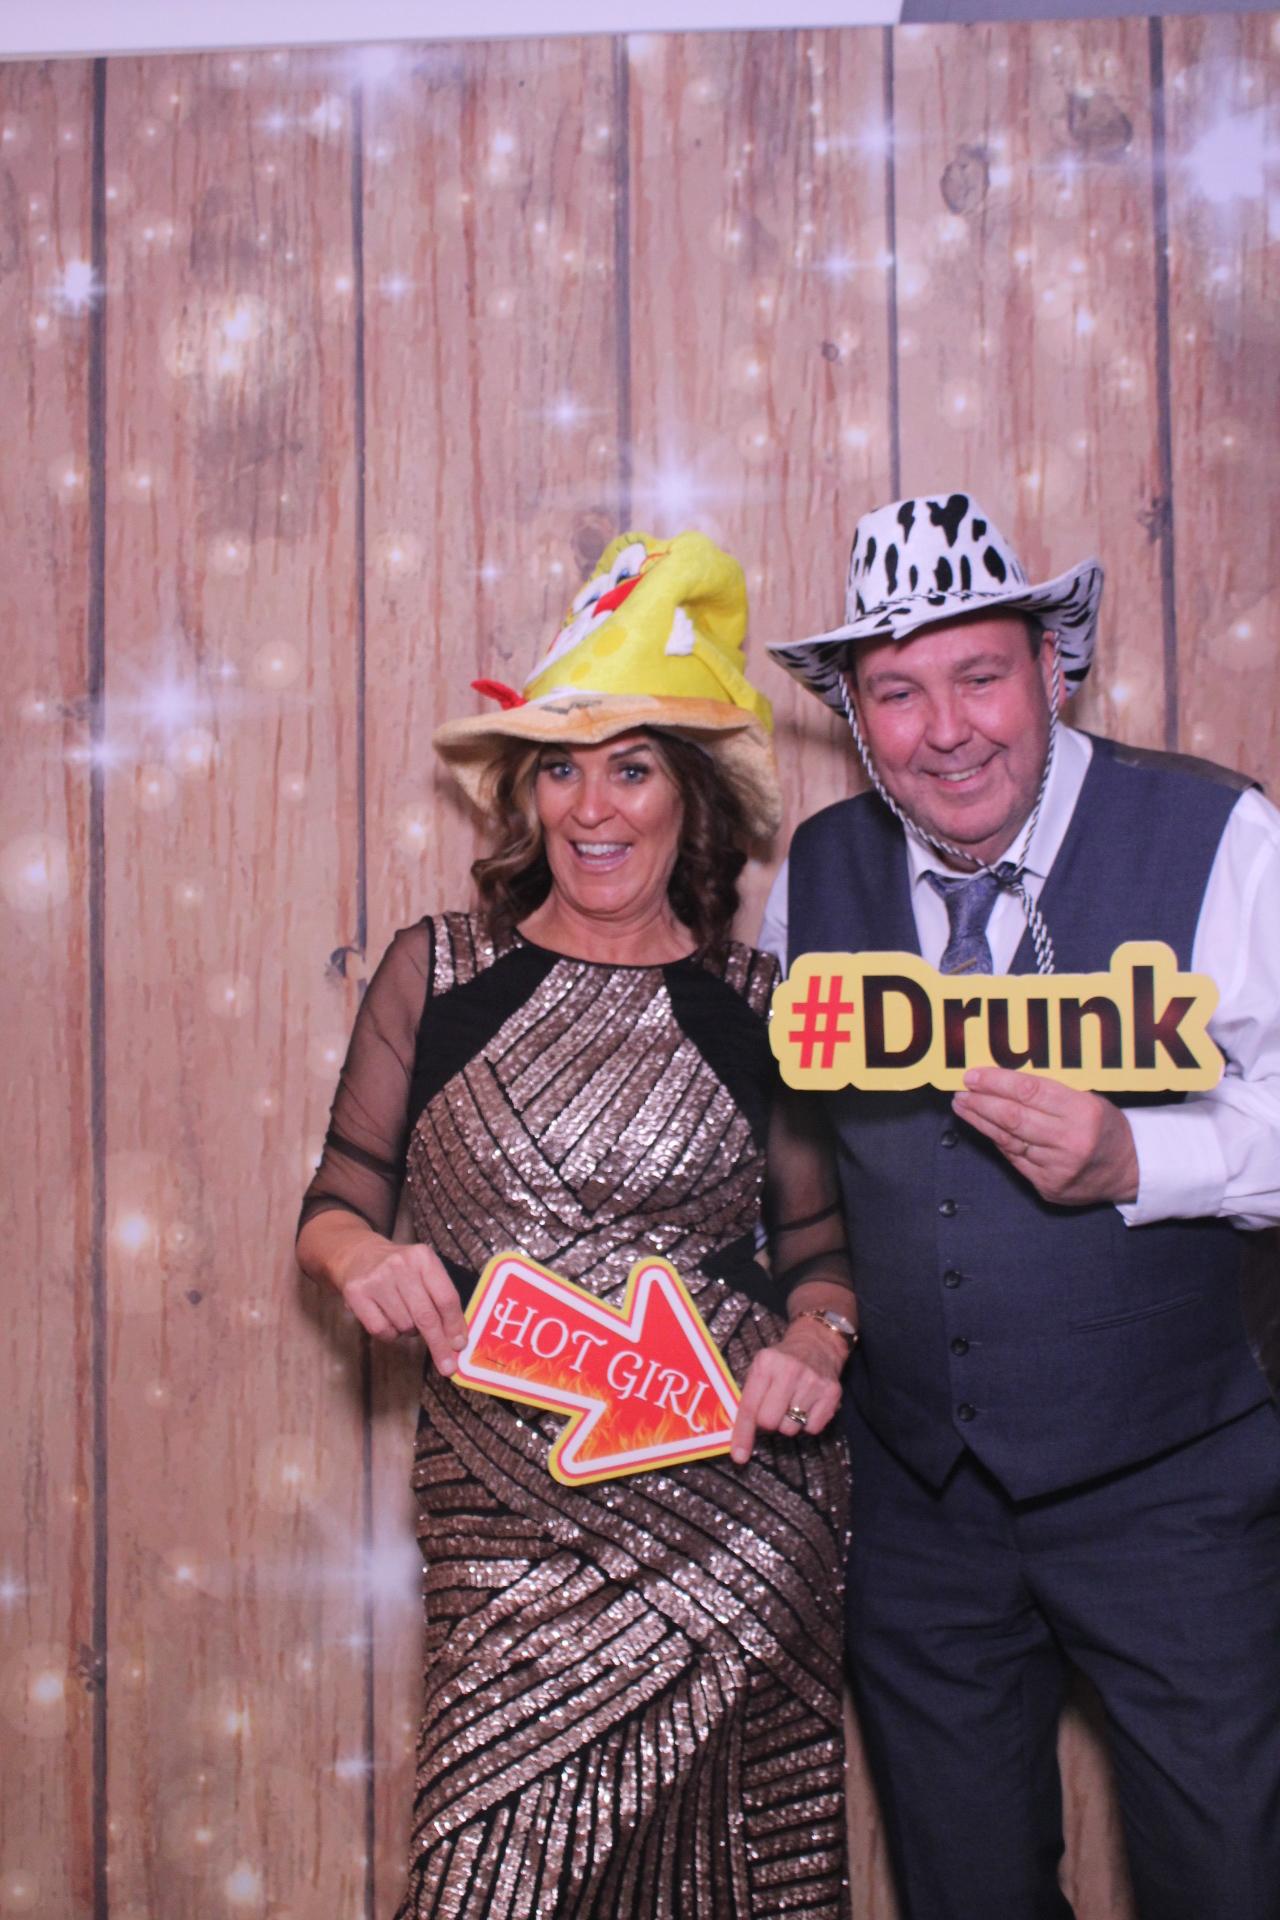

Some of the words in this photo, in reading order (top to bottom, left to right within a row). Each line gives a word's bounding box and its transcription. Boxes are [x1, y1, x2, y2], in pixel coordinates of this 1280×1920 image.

[789, 964, 1202, 1069] #Drunk
[491, 1297, 608, 1373] HOT
[606, 1351, 710, 1433] GIRL
